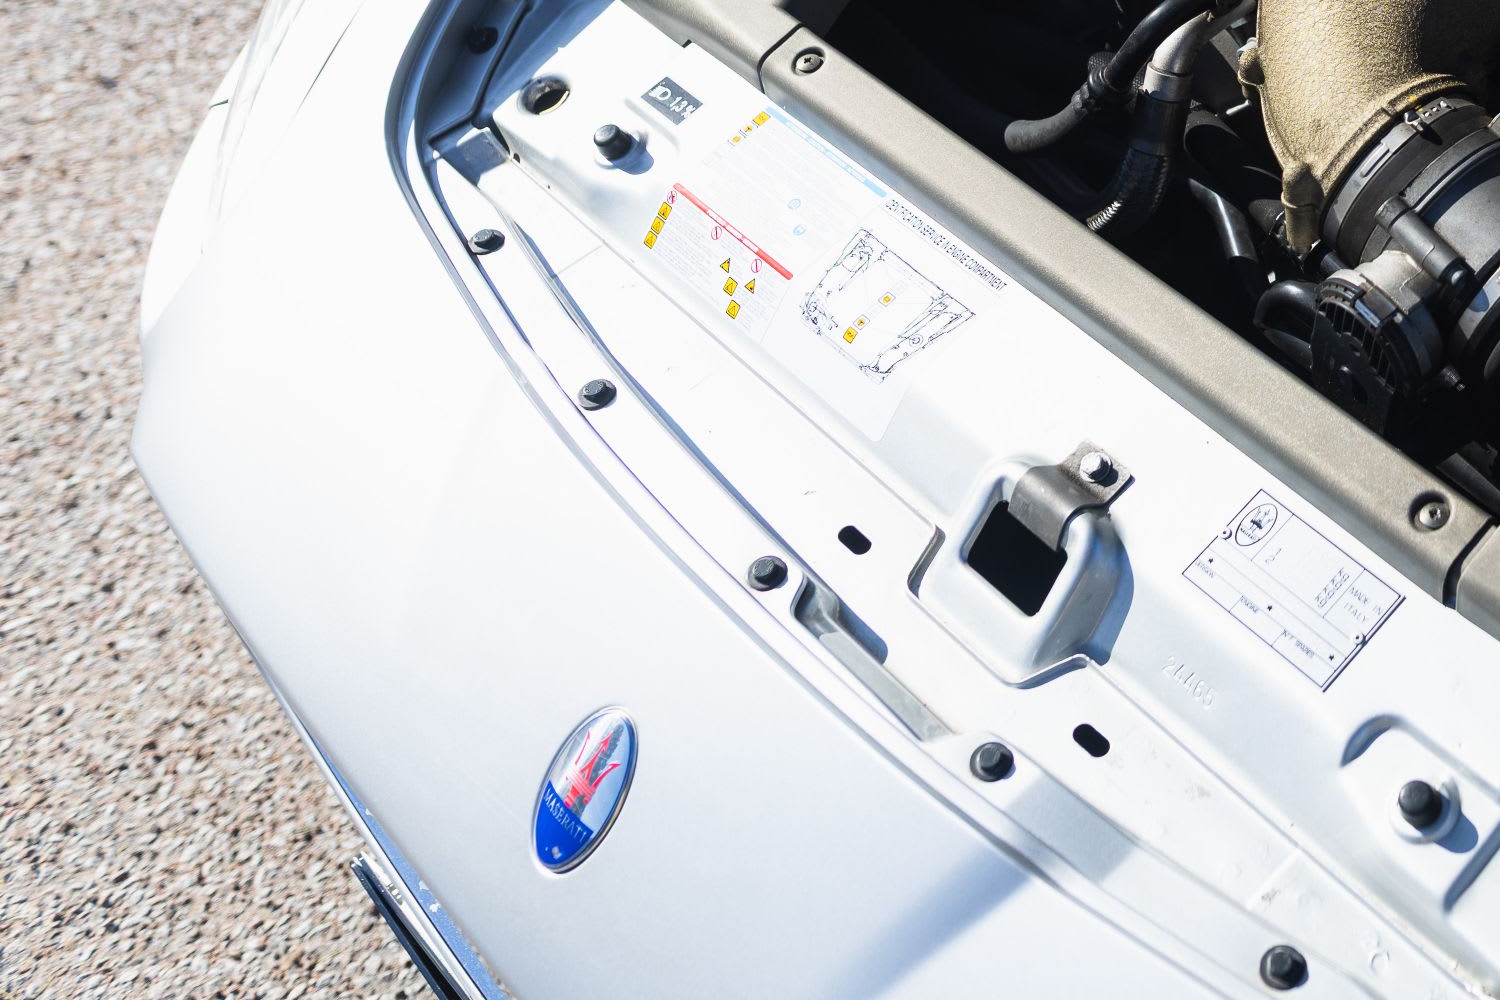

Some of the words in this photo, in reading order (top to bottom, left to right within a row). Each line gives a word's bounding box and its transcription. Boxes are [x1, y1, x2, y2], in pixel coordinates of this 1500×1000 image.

[920, 226, 945, 246] SERVICE
[946, 245, 970, 264] ENGINE
[965, 259, 1008, 291] COMPARTMENT
[543, 788, 587, 843] MASERATI
